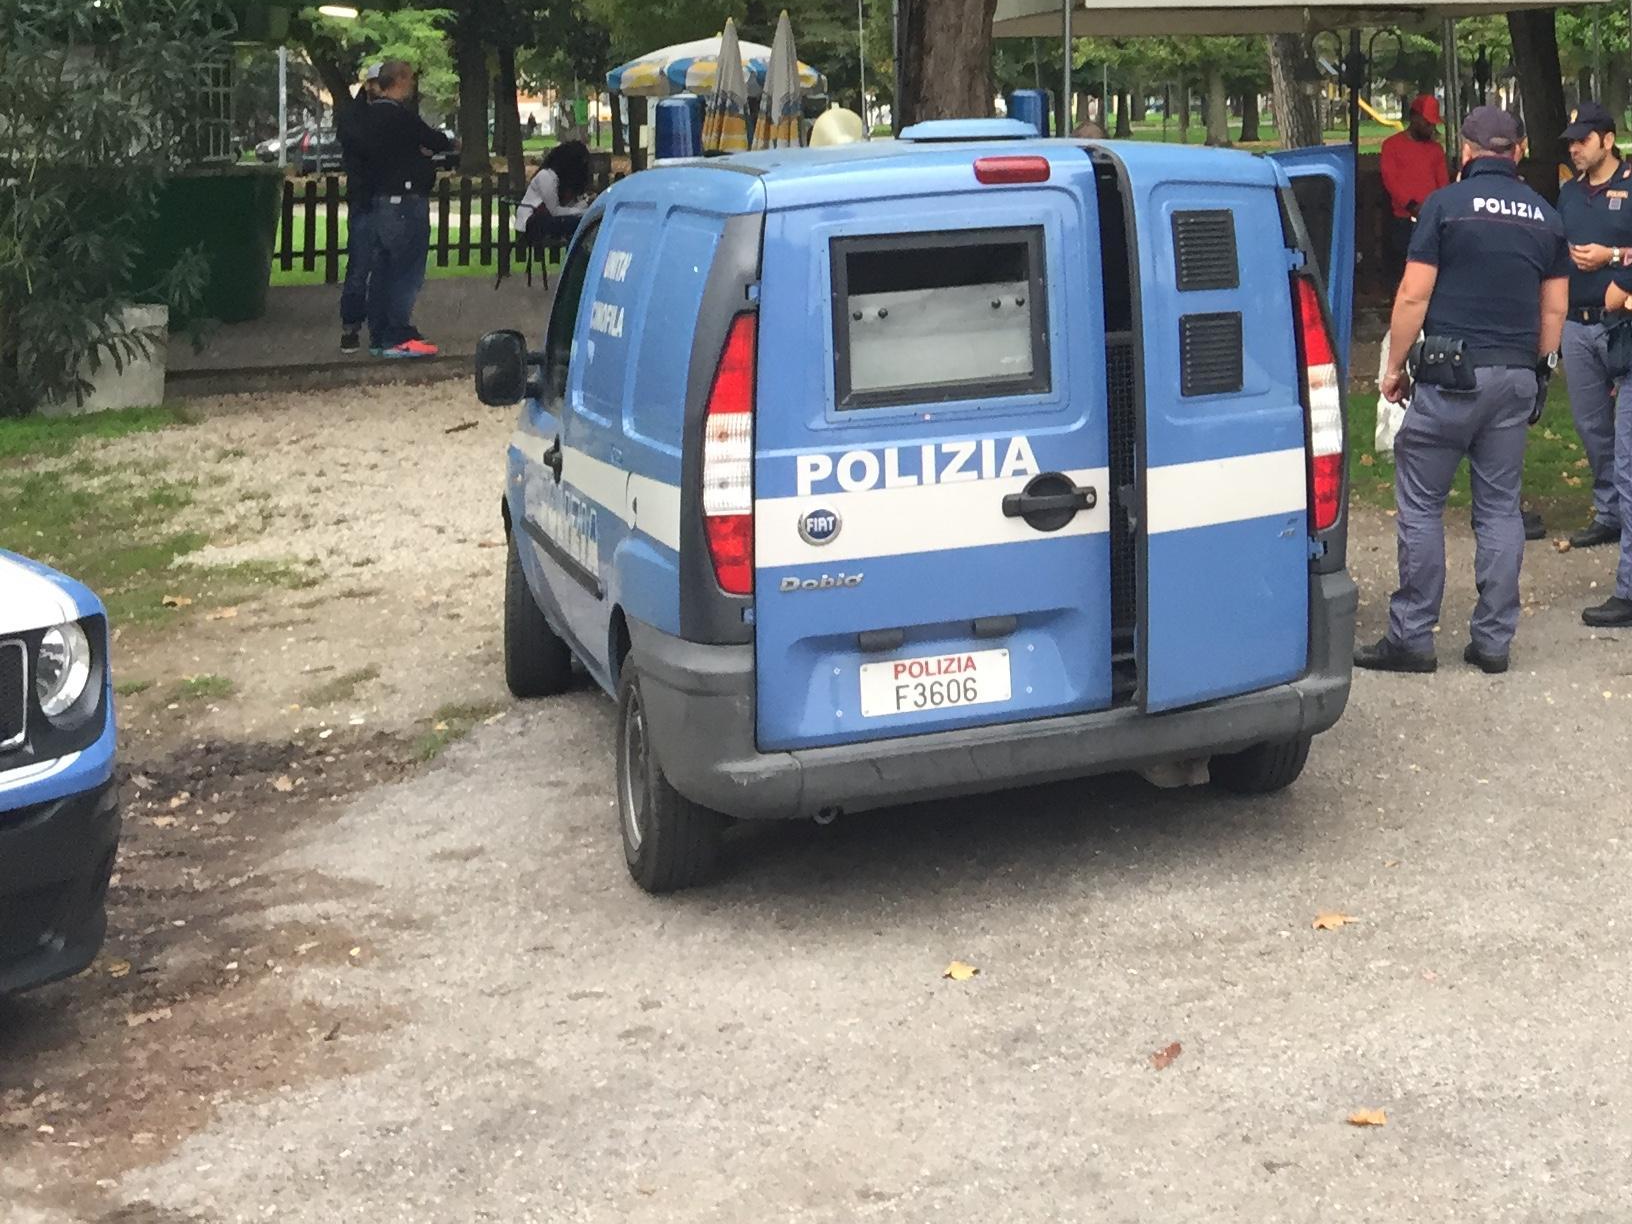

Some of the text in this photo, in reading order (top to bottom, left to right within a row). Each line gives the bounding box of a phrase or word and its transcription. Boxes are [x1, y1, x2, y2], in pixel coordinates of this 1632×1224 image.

[1473, 197, 1544, 222] POLIZIA
[796, 435, 1041, 497] POLIZIA
[806, 516, 835, 533] FIAT
[893, 656, 977, 680] POLIZIA
[895, 677, 978, 710] F3606
